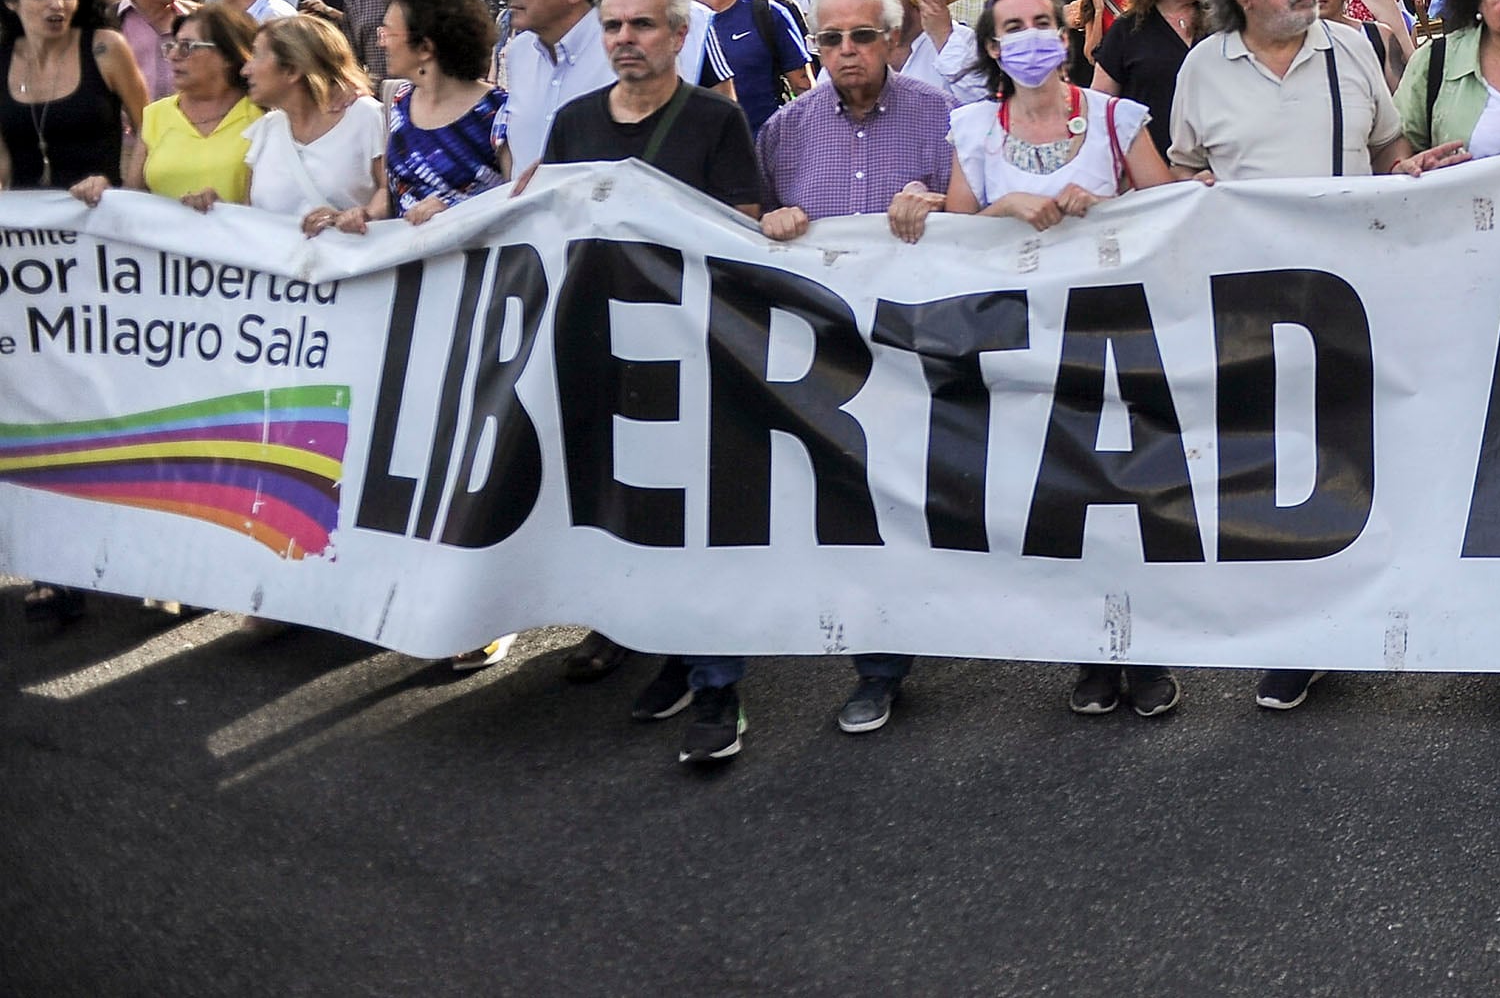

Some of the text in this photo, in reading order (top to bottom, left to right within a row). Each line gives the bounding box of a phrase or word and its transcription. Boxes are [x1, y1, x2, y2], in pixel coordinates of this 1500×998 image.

[0, 257, 77, 296] or
[97, 244, 141, 294] la
[27, 304, 223, 368] Milagro
[235, 313, 329, 369] Sala
[355, 238, 1375, 563] LIBERTAD
